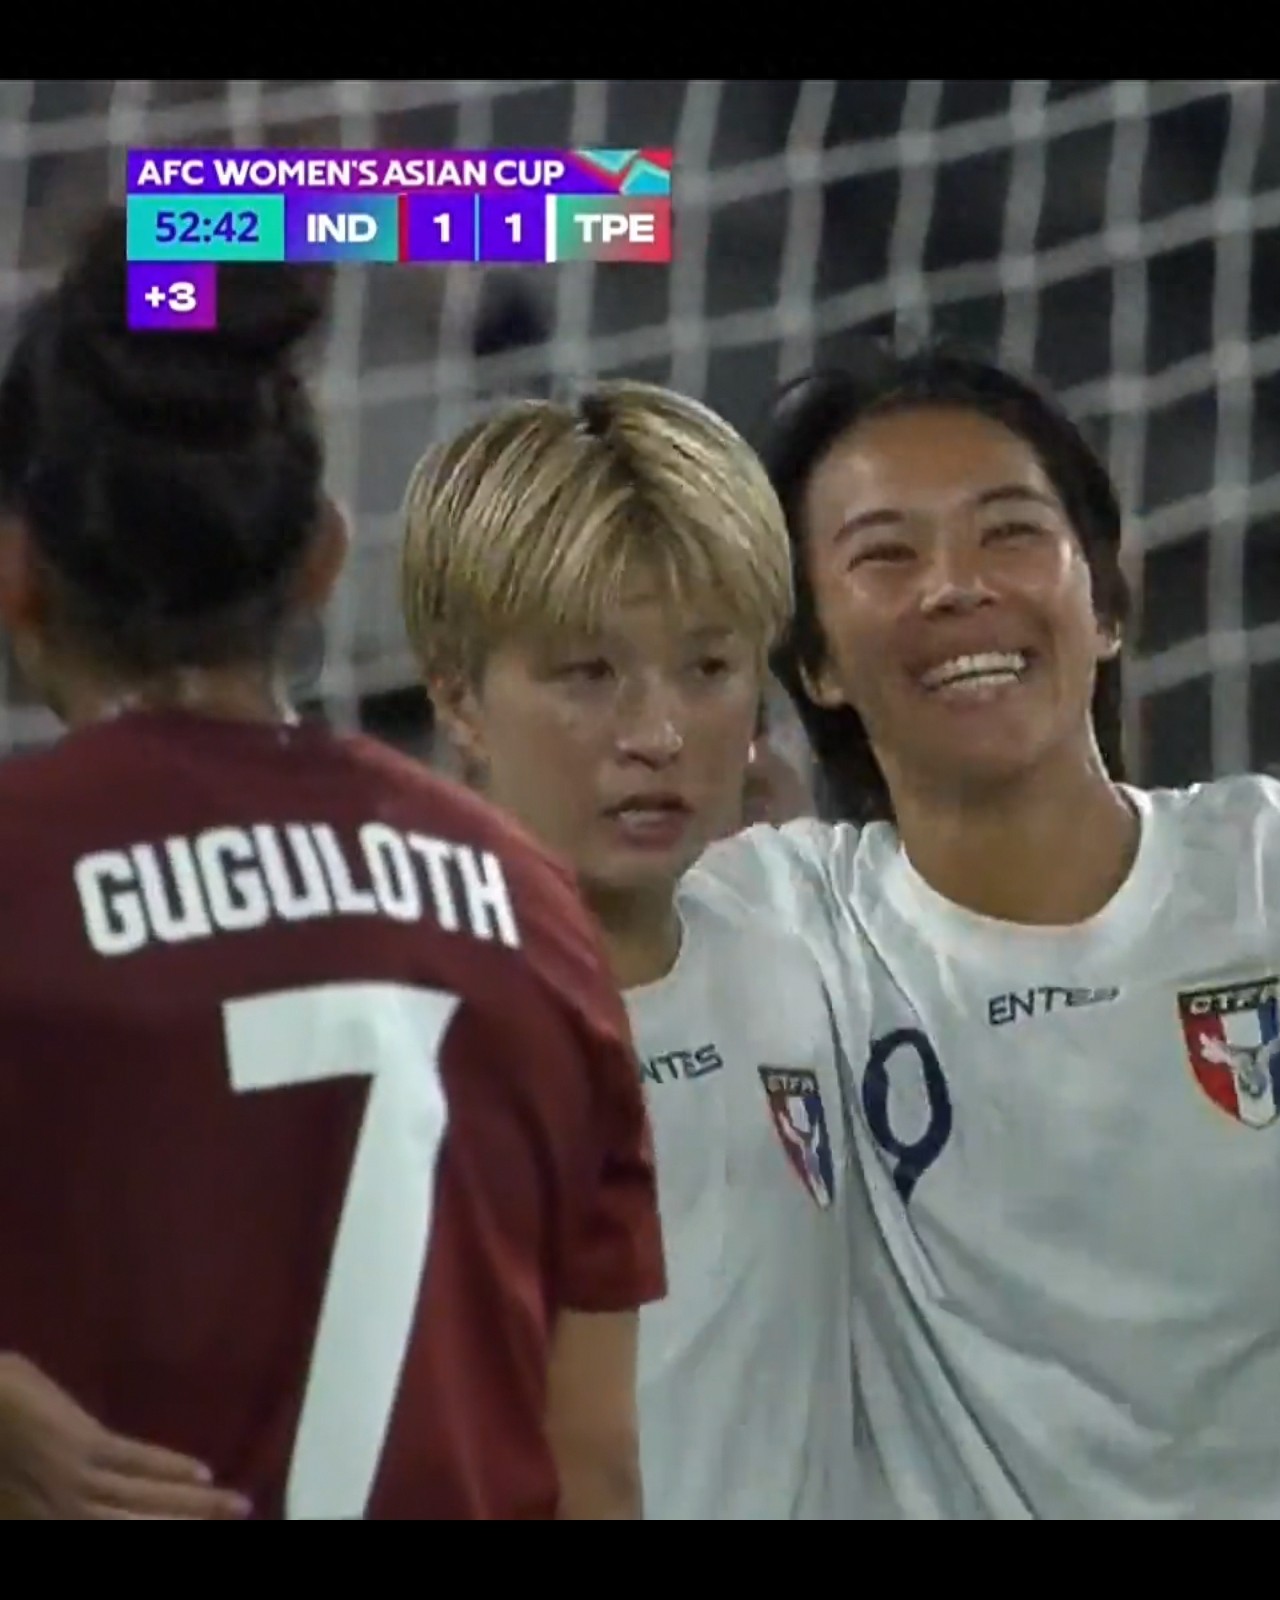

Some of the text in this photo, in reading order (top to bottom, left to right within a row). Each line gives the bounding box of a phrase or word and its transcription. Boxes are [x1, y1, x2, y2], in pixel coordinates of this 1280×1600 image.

[73, 821, 521, 957] GUGULOTH
[639, 1043, 723, 1084] NTES
[221, 981, 461, 1520] 7
